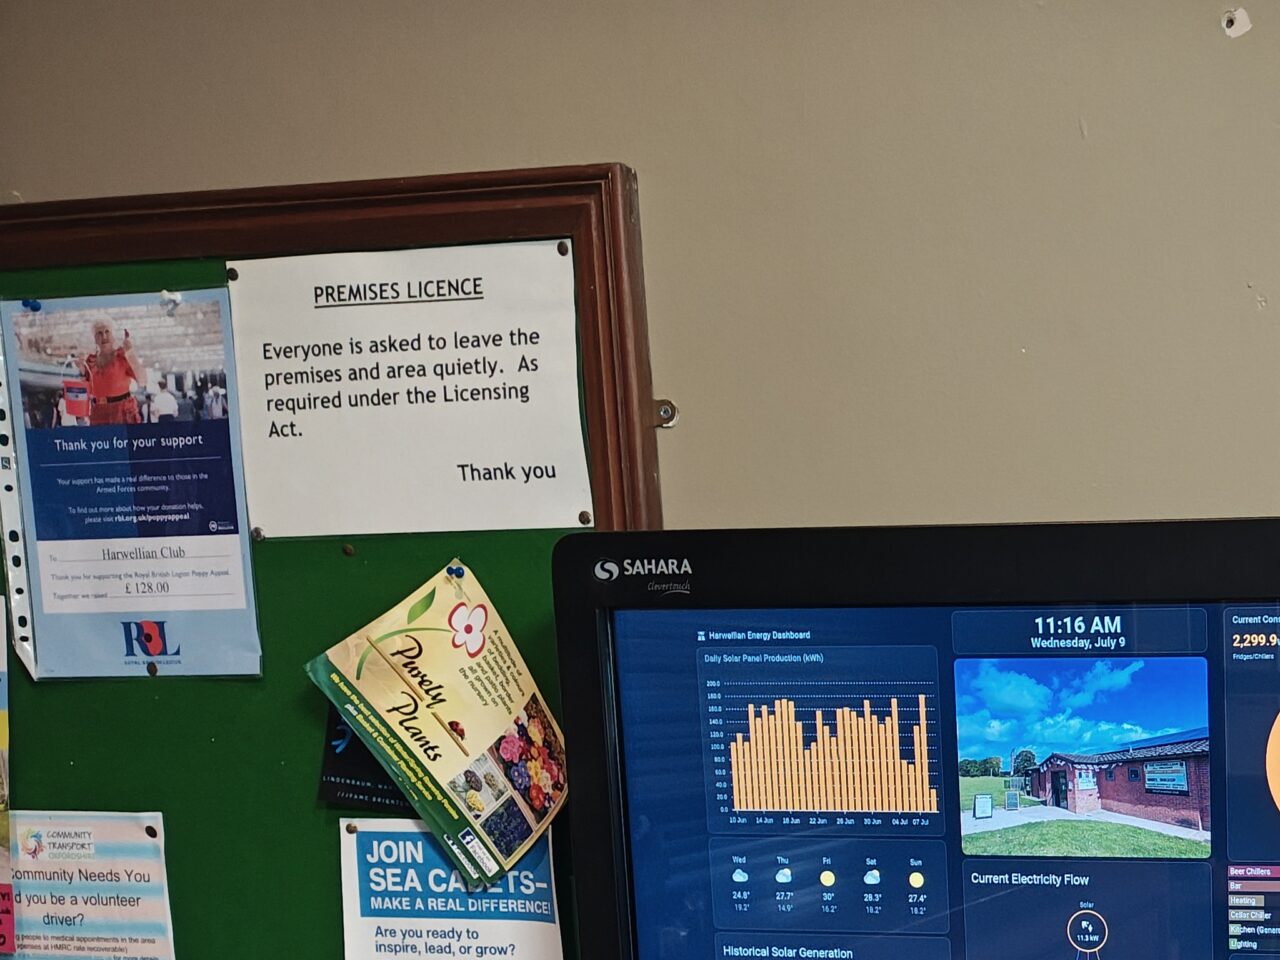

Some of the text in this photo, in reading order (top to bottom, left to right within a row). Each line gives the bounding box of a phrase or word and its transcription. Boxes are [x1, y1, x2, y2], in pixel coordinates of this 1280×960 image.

[314, 278, 484, 303] PREMISES LICENCE
[263, 328, 540, 361] Everyone is asked to leave the
[264, 355, 539, 389] premises and area quietly. As
[267, 383, 530, 415] required under the Licensing
[268, 421, 303, 437] Act.
[55, 435, 203, 452] Thank you for your support
[457, 463, 556, 483] Thank you
[102, 547, 185, 561] Harwellian Club
[623, 558, 692, 575] SAHARA
[125, 581, 170, 594] £ 128.00
[1035, 616, 1121, 634] 11:16 AM
[1232, 615, 1260, 624] Current
[709, 631, 810, 641] Harwellian Energy Dashboard
[1031, 636, 1125, 650] Wednesday, July 9
[704, 654, 824, 664] Daily Solar Panel Production (kWh)
[390, 635, 447, 710] Purely
[386, 691, 442, 763] Plants
[46, 831, 92, 840] COMMUNITY
[47, 842, 93, 850] TRANSPORT
[366, 840, 423, 864] JOIN
[79, 870, 150, 883] Needs You
[1230, 867, 1245, 875] Beer
[1246, 867, 1270, 876] Chillers
[369, 868, 422, 892] SEA
[971, 873, 1089, 887] Current Electricity Flow
[26, 893, 141, 908] you be a volunteer
[371, 897, 551, 914] MAKE A REAL DIFFERENCE!
[43, 913, 84, 927] driver?
[375, 926, 479, 942] Are you ready to
[375, 941, 515, 957] inspire, lead, or grow?
[723, 946, 853, 959] Historical Solar Generation
